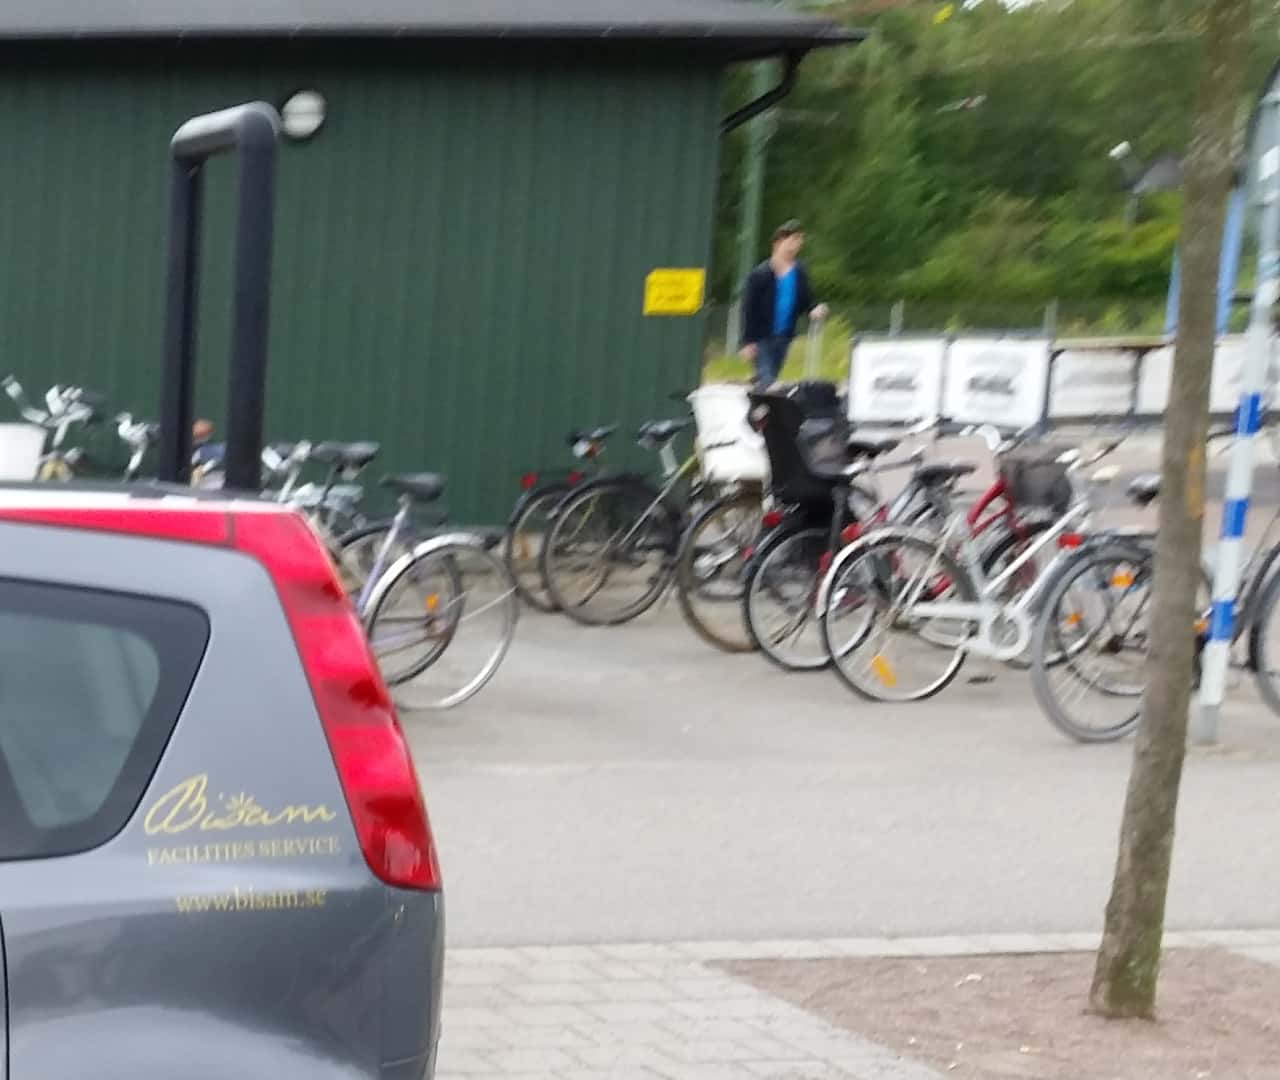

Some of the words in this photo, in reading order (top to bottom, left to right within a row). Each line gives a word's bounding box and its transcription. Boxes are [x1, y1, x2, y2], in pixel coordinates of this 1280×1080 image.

[144, 773, 336, 835] Bisam
[146, 841, 255, 866] FACILITIES
[259, 837, 338, 857] SERVICE
[176, 882, 327, 913] www.bisam.se
